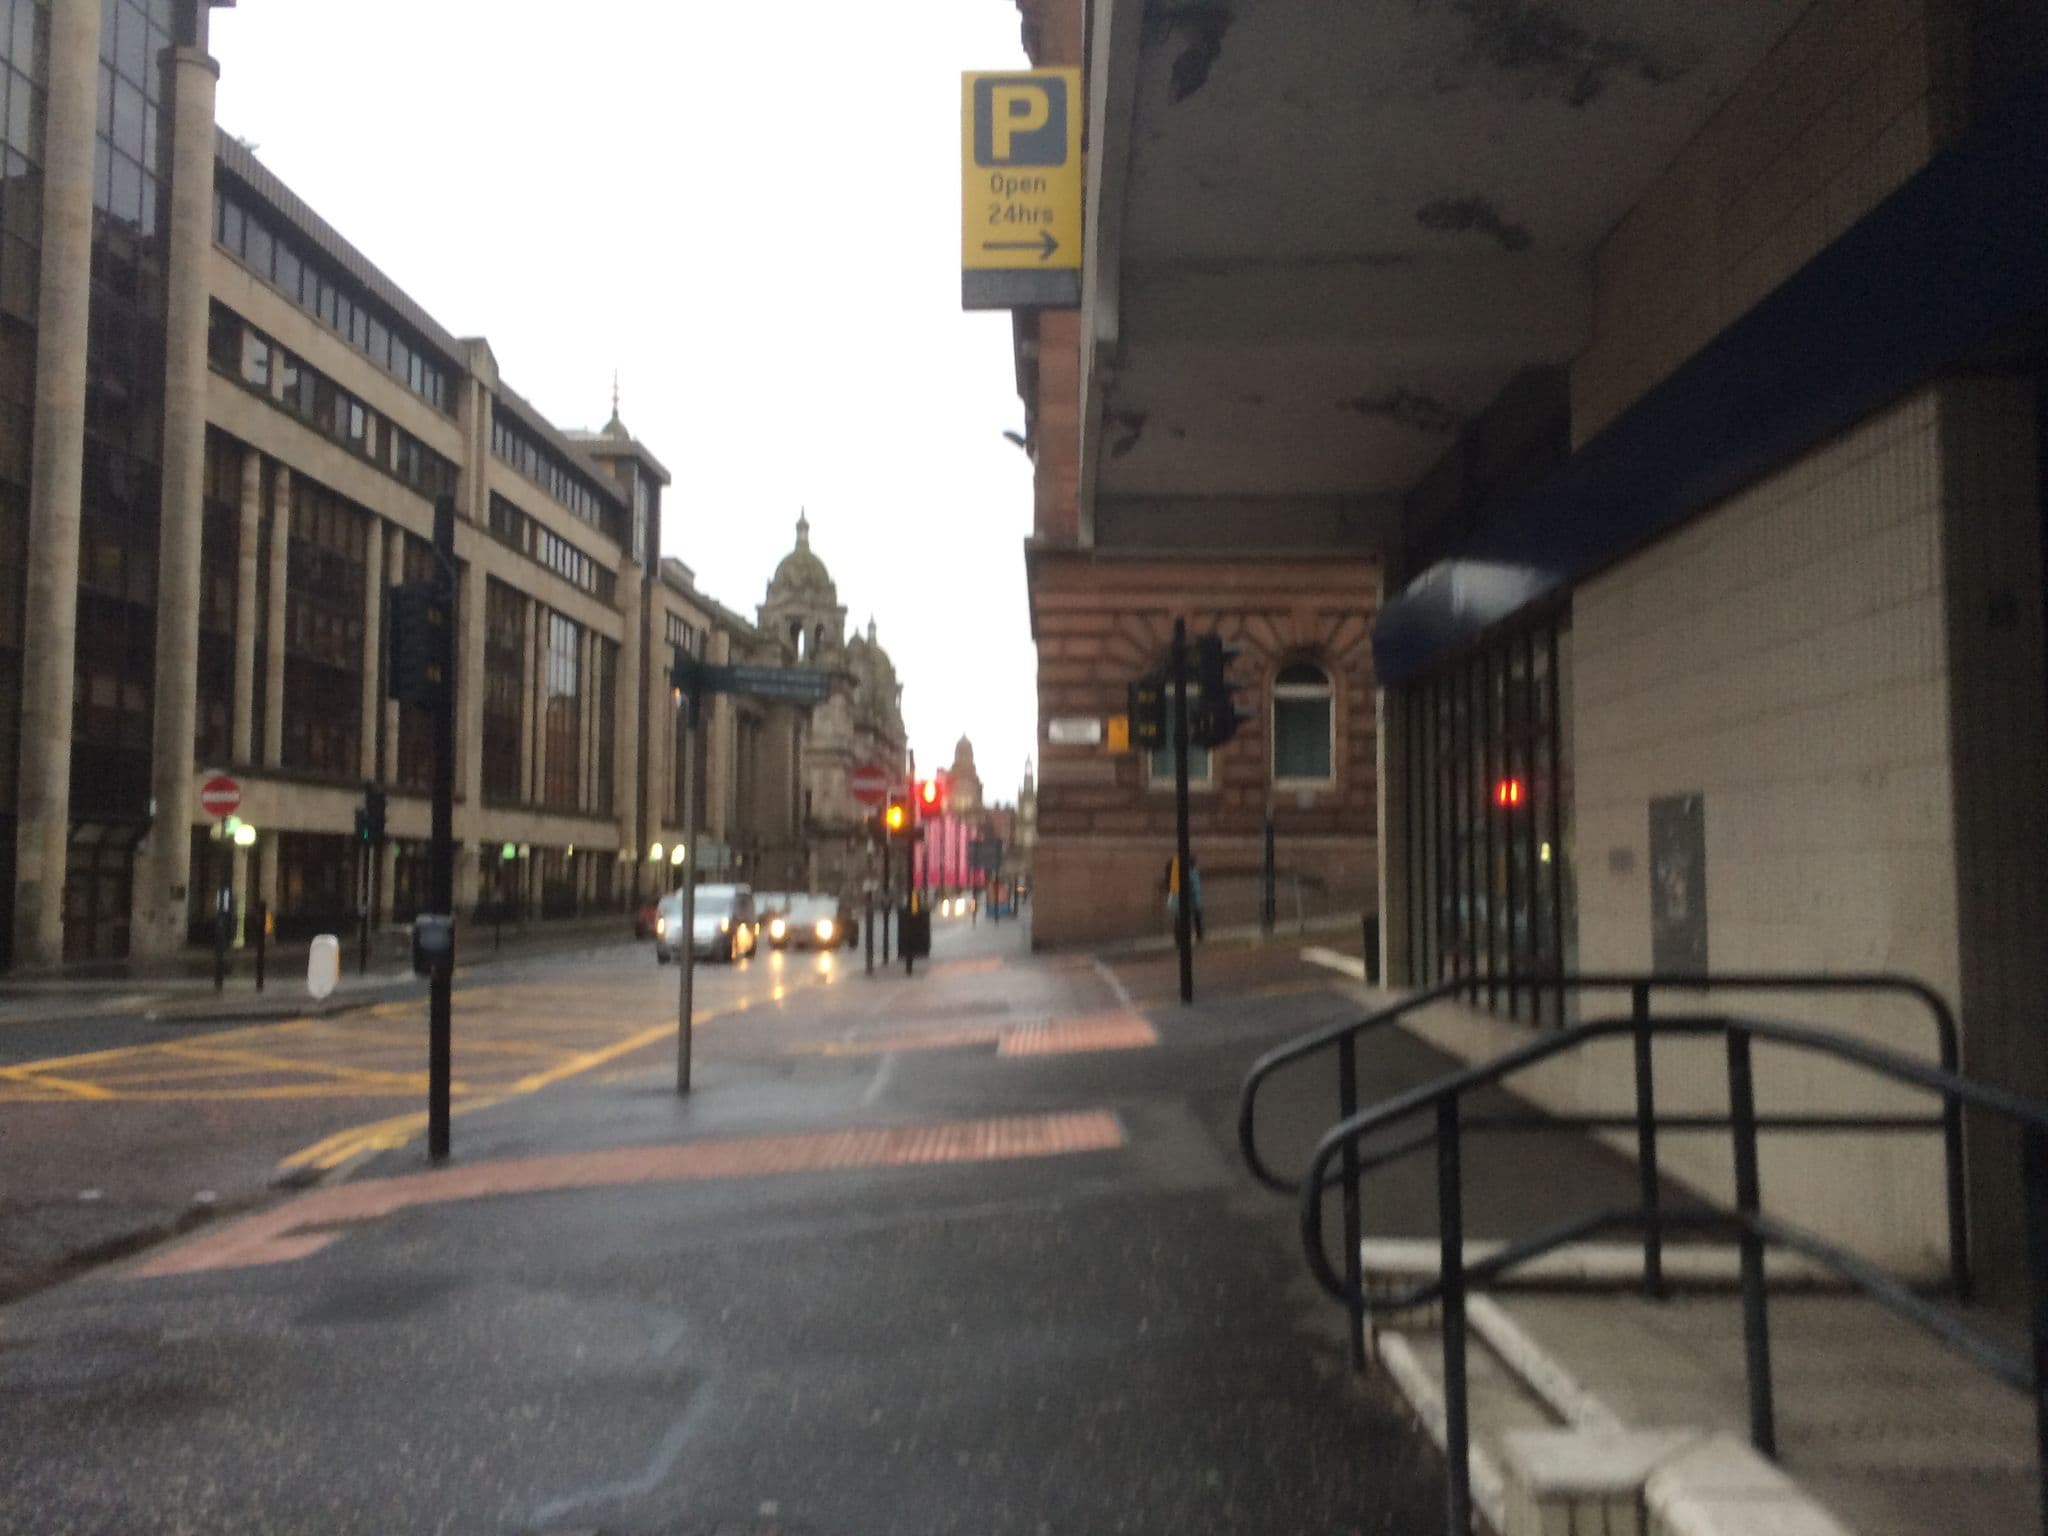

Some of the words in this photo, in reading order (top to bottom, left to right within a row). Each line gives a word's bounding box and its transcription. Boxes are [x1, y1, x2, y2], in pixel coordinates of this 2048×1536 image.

[991, 85, 1049, 159] P
[990, 173, 1046, 199] Open
[988, 203, 1053, 225] 24hrs
